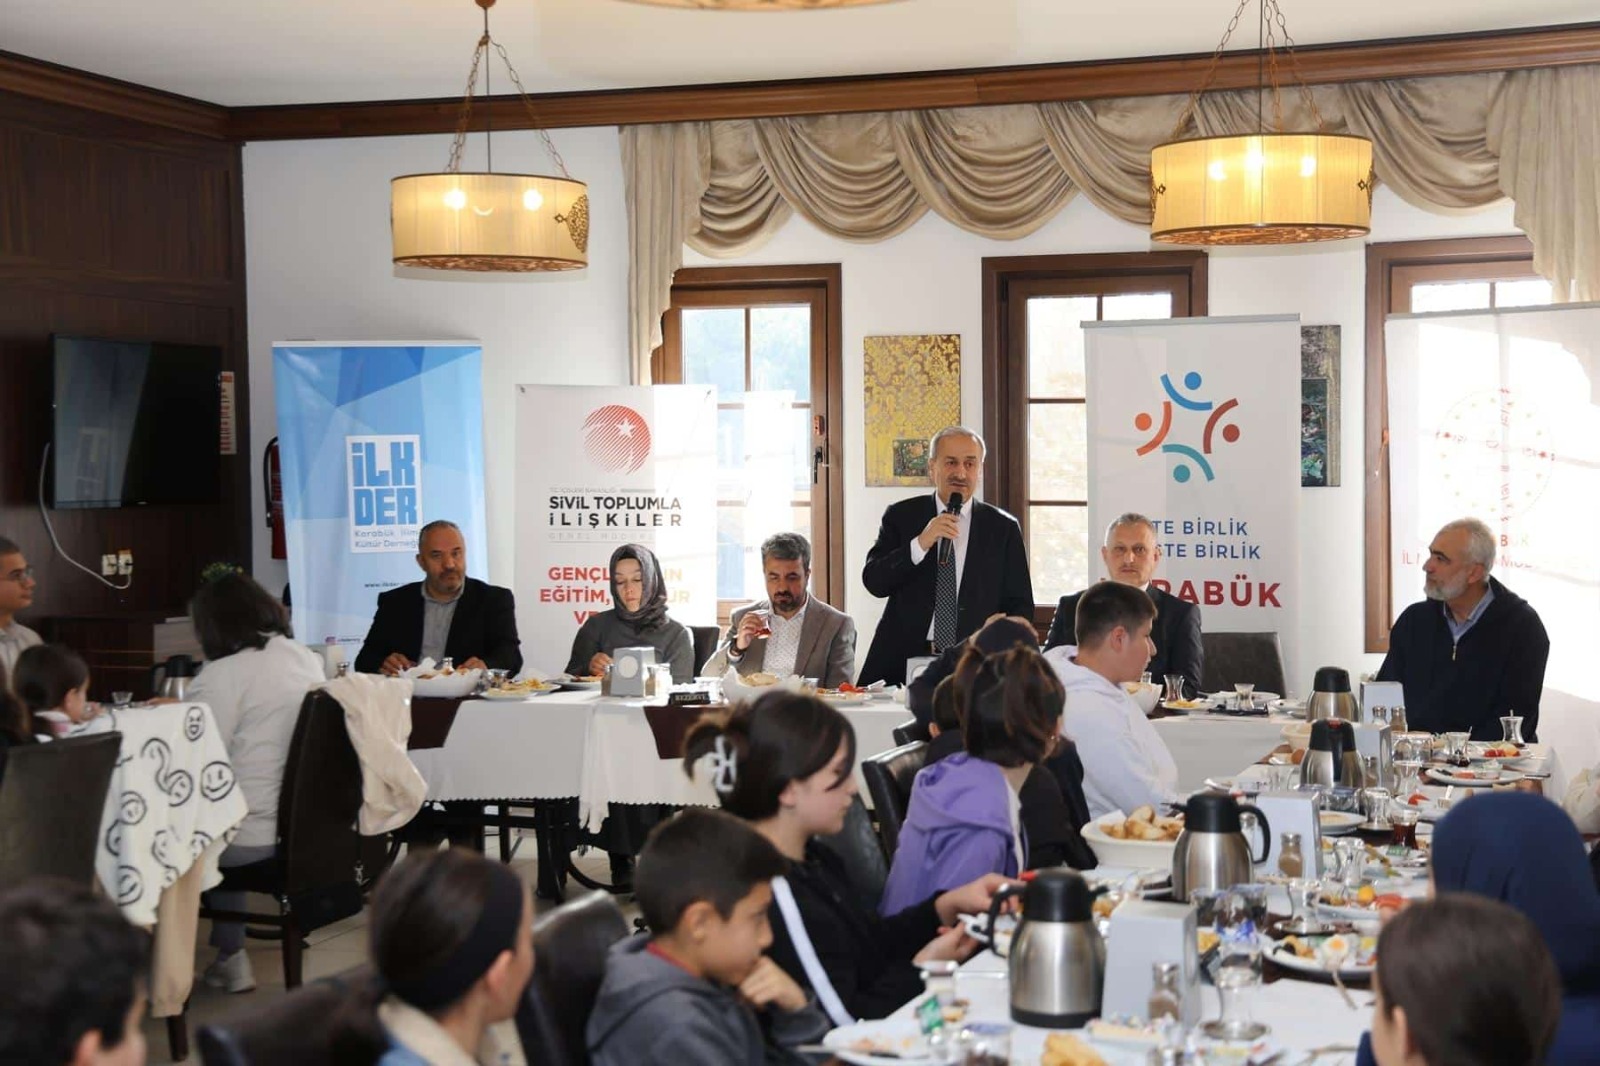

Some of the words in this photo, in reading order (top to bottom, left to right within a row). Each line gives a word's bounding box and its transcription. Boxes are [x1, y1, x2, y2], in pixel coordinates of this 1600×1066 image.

[354, 487, 418, 526] DER
[593, 496, 682, 510] TOPLUMLA
[1150, 520, 1174, 535] TE
[1183, 517, 1248, 536] BİRLİK
[1195, 540, 1261, 560] BİRLİK
[548, 566, 612, 583] GENÇL
[540, 585, 610, 605] EĞİTİM,
